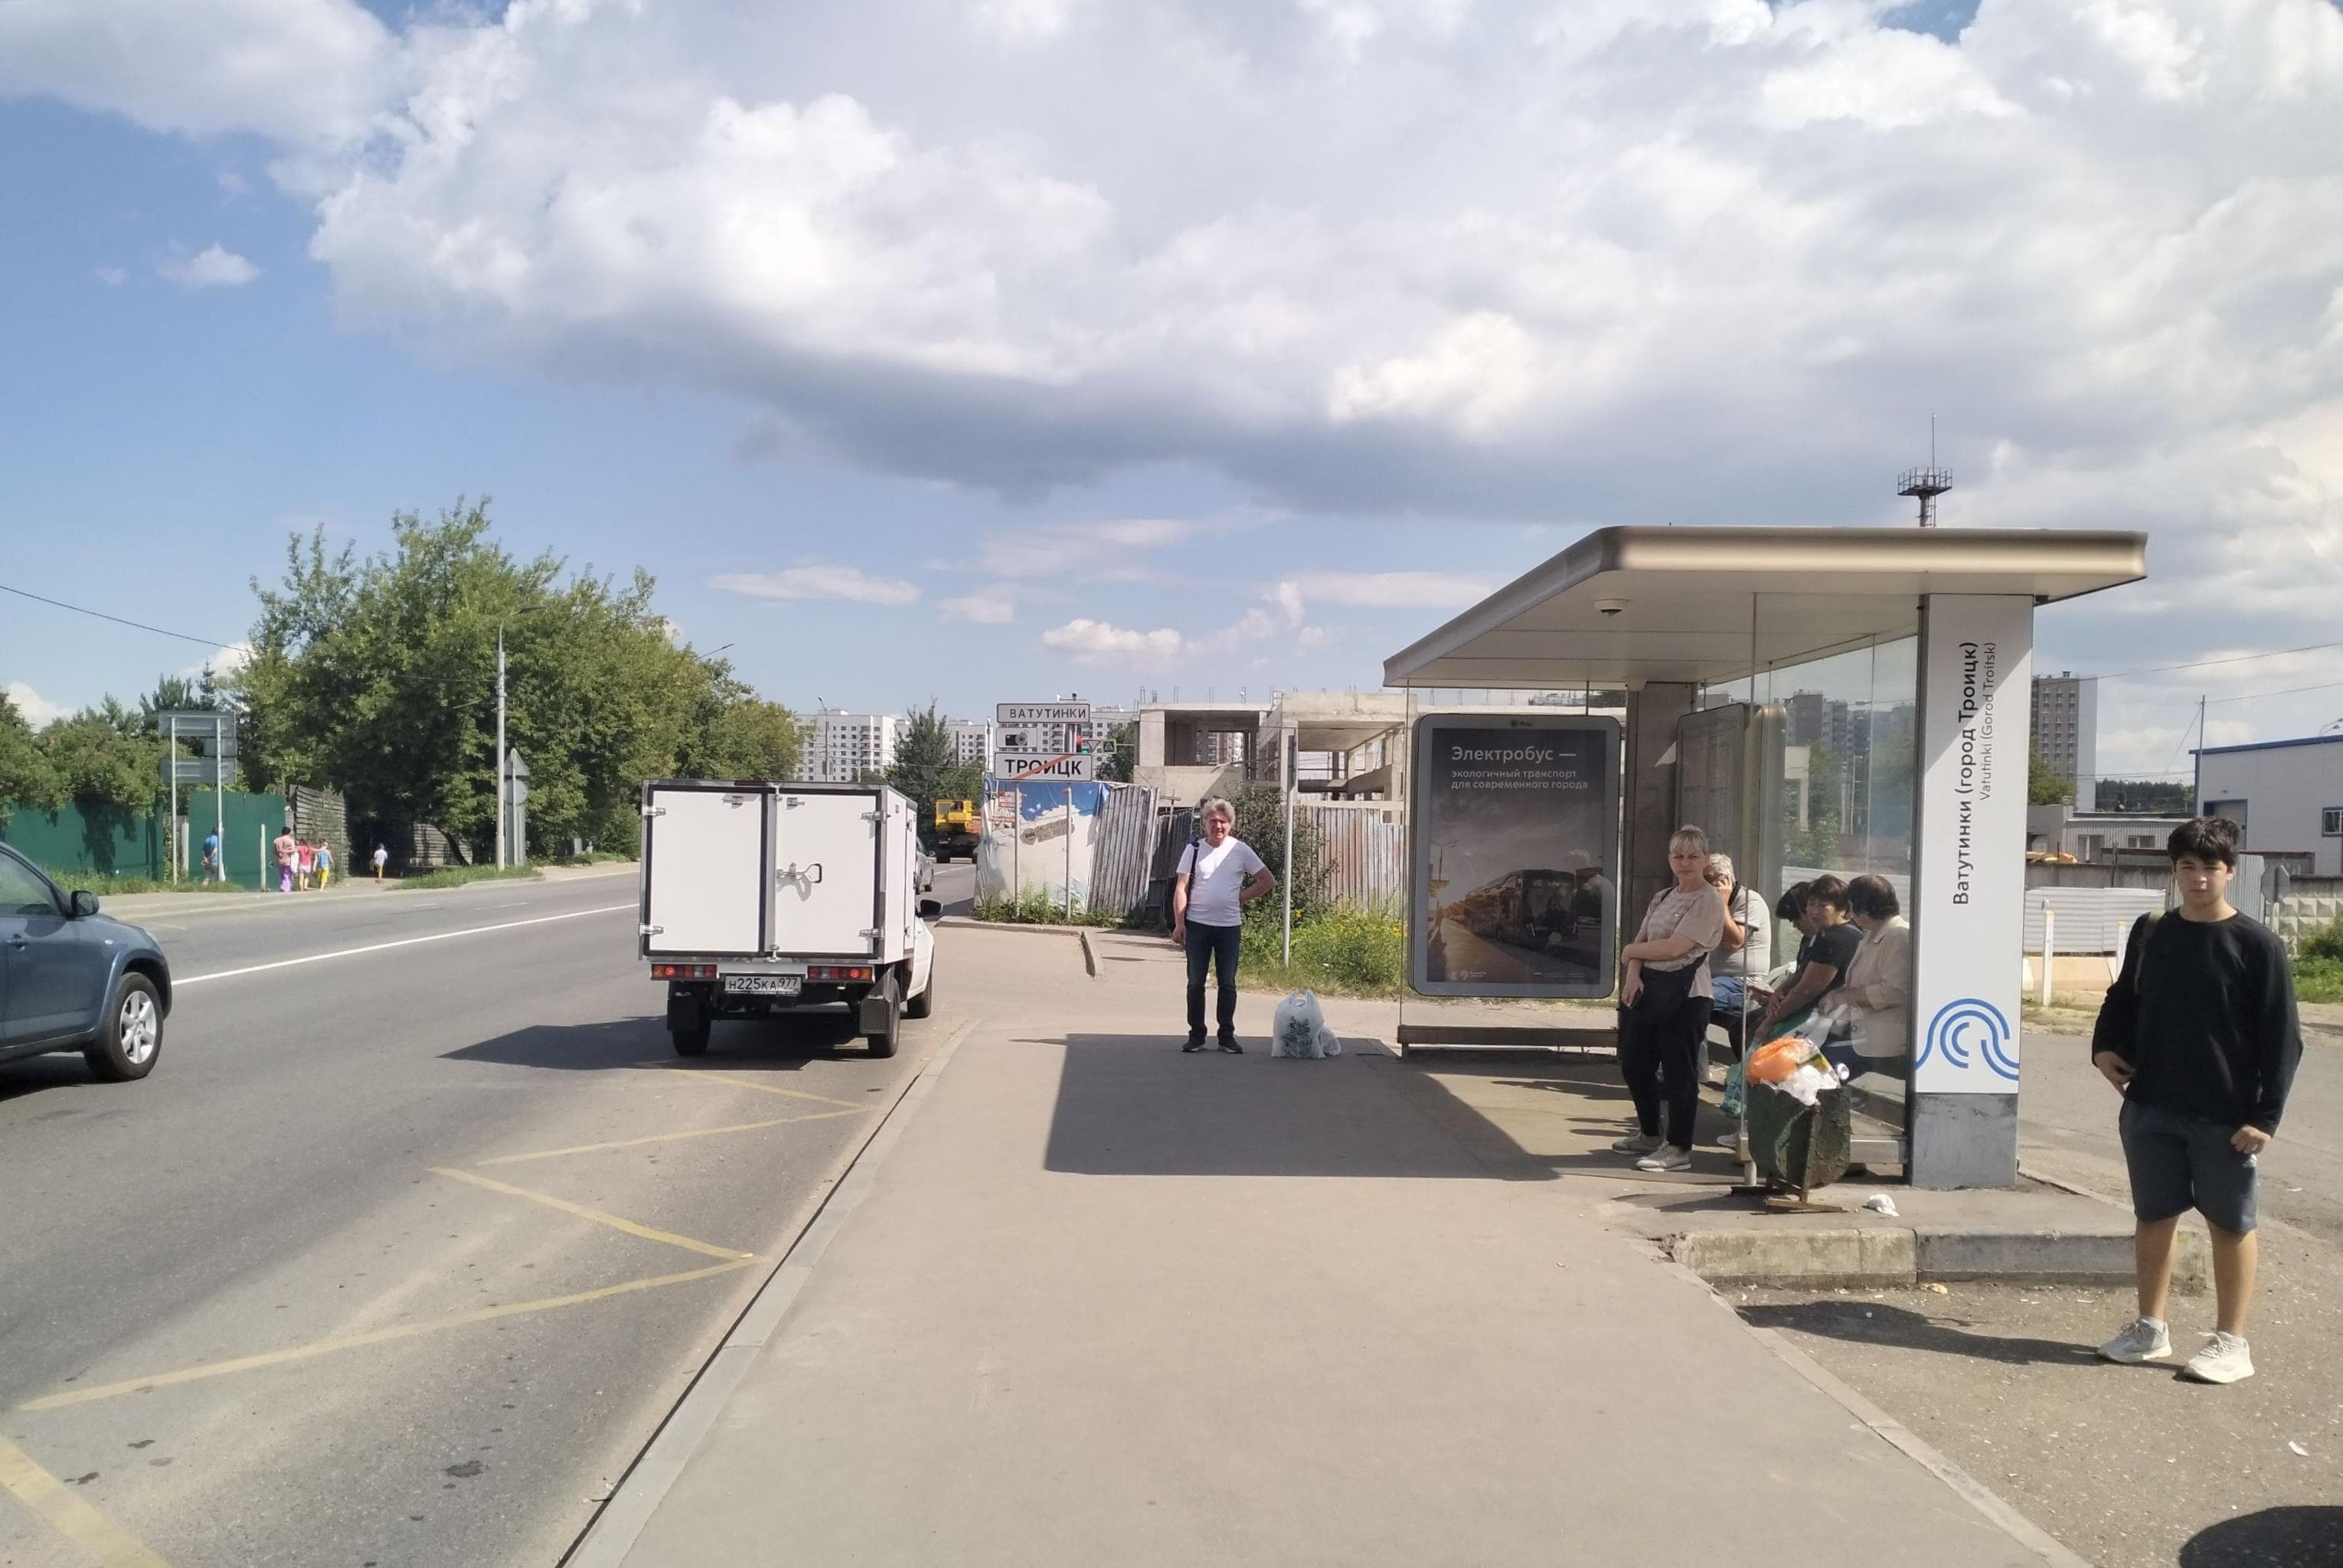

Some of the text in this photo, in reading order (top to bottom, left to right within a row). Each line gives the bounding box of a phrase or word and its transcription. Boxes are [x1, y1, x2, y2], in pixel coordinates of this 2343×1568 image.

[1009, 708, 1086, 719] ВАТУТИНКИ
[1979, 642, 1996, 801] Vatutinki (Gorod Troitsk)
[1451, 746, 1554, 764] Электробус
[1005, 759, 1083, 778] ТРОИЦК
[1452, 769, 1577, 779] экологичный транспорт
[1953, 642, 1979, 905] Ватутинки (город Троицк)
[1451, 781, 1588, 790] для современного города
